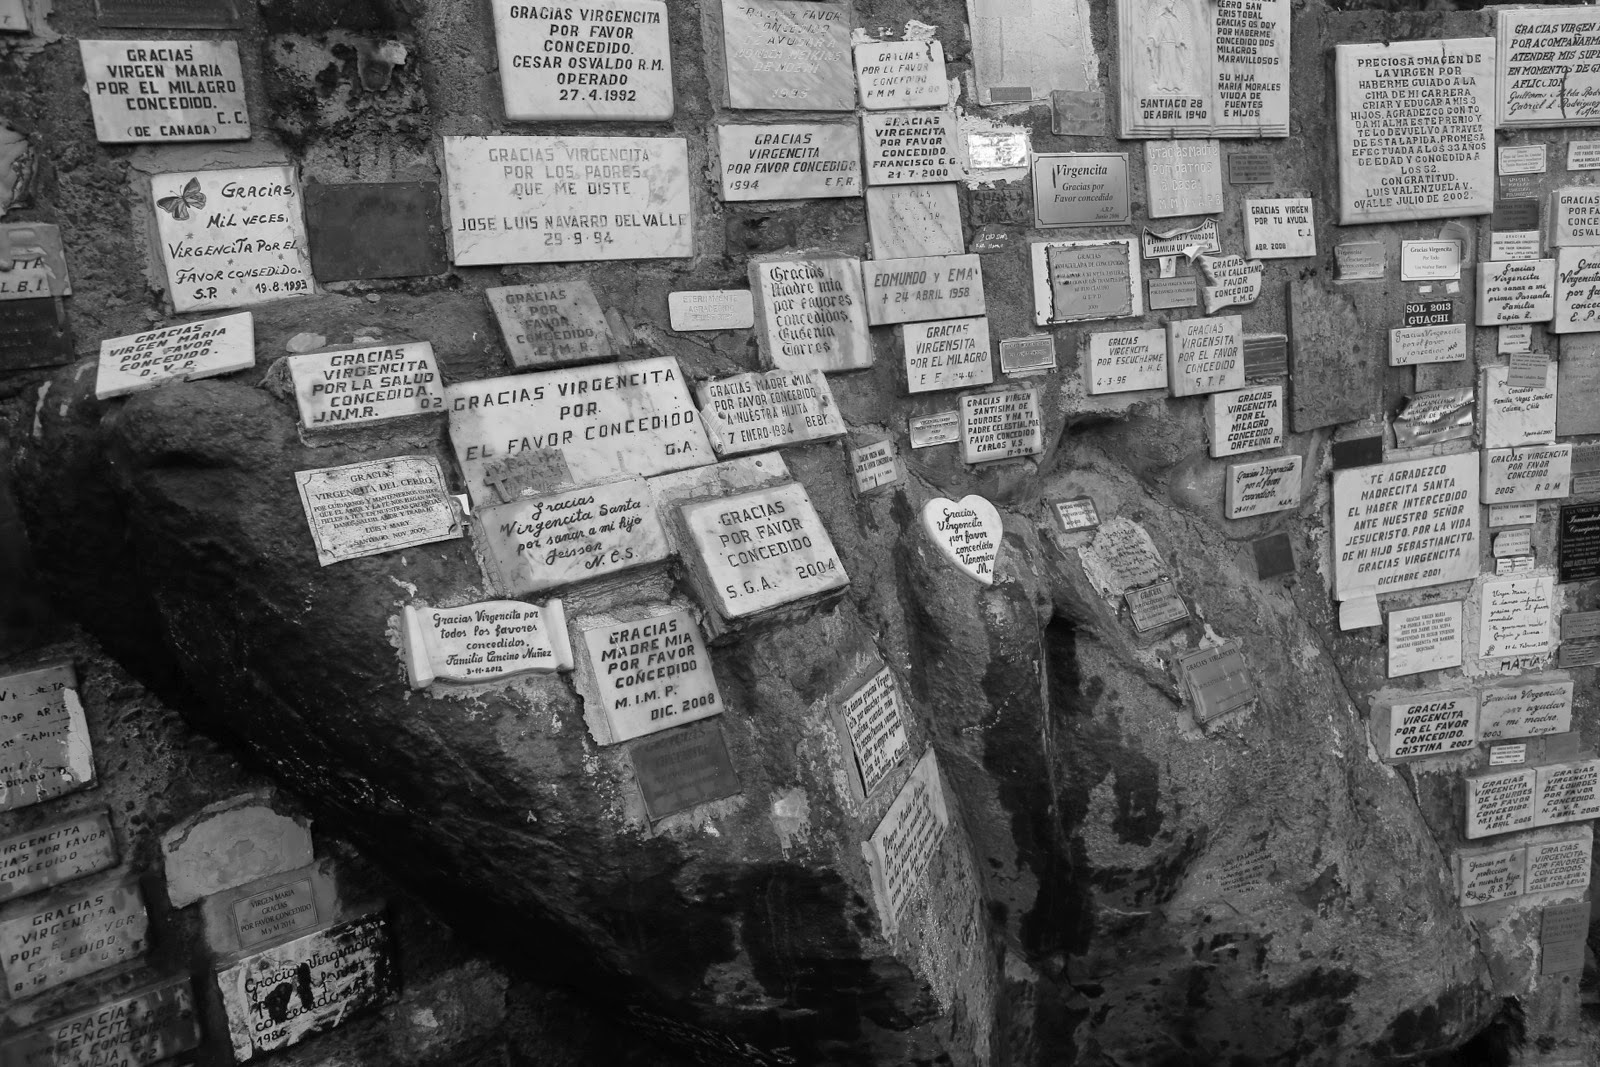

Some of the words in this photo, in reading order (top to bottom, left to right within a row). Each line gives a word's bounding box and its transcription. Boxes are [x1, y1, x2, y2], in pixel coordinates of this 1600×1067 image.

[1217, 1, 1243, 10] CERRO
[1245, 2, 1261, 10] SAN
[510, 5, 573, 20] GRACIAS
[581, 9, 661, 23] VIRGENCITA
[1218, 10, 1263, 19] CRISTOBAL
[550, 25, 579, 37] POR
[590, 25, 633, 39] FAVOR
[544, 40, 634, 55] CONCEDIDO.
[128, 49, 193, 62] GRACIAS
[513, 56, 562, 68] CESAR
[568, 57, 633, 70] OSVALDO
[107, 65, 164, 78] VIRGEN
[177, 65, 222, 77] MARIA
[557, 73, 628, 85] OPERADO
[1412, 78, 1450, 86] GUIADO
[1460, 77, 1476, 86] LA
[97, 82, 129, 95] POR
[140, 81, 159, 94] EL
[169, 80, 236, 94] MILAGRO
[1218, 82, 1242, 90] MARIA
[1245, 83, 1281, 91] MORALES
[127, 97, 217, 109] CONCEDIDO.
[1140, 98, 1186, 108] SANTIAGO
[1191, 98, 1203, 108] 28
[1185, 110, 1207, 119] 1940
[128, 125, 151, 137] (DE
[160, 125, 217, 137] CANADA)
[875, 128, 946, 137] VIRGENCITA
[755, 133, 812, 145] GRACIAS
[880, 138, 900, 146] POR
[906, 137, 942, 145] FAVOR
[749, 147, 820, 159] VIRGENCITA
[727, 164, 751, 174] POR
[754, 163, 788, 173] FAVOR
[873, 159, 934, 168] FRANCISCO
[504, 166, 533, 178] POR
[546, 165, 574, 178] LOS
[1053, 164, 1107, 179] Virgencita
[514, 183, 543, 195] QUE
[555, 183, 577, 195] ME
[589, 183, 630, 195] DISTE
[730, 179, 759, 190] 1994
[1062, 182, 1091, 192] Gracias
[1093, 183, 1104, 192] por
[1366, 189, 1389, 197] LUIS
[1392, 184, 1460, 195] VALENZUELA
[1054, 194, 1076, 203] Favor
[1078, 193, 1113, 202] concedido
[1354, 198, 1392, 208] OVALLE
[1396, 195, 1424, 205] JULIO
[1427, 194, 1439, 202] DE
[1444, 191, 1473, 201] 2002.
[1251, 206, 1280, 215] GRACIAS
[1285, 206, 1309, 215] VIRGEN
[458, 218, 497, 231] JOSE
[504, 217, 538, 230] LUIS
[545, 216, 607, 229] NAVARRO
[1255, 217, 1268, 225] POR
[282, 240, 298, 251] EL
[176, 269, 223, 283] FAVOR
[874, 271, 926, 287] EDMUNDO
[948, 270, 973, 281] EMA
[1406, 305, 1426, 313] SOL
[1430, 303, 1451, 311] 2013
[1409, 314, 1448, 324] GUACHI
[330, 349, 404, 366] GRACIAS
[323, 360, 428, 380] VIRGENCITA
[313, 381, 346, 395] POR
[352, 380, 372, 391] LA
[381, 373, 434, 387] SALUD
[454, 386, 544, 411] GRACIAS
[558, 369, 675, 396] VIRGENCITA
[330, 386, 433, 407] CONCEDIDA.
[560, 402, 597, 419] POR
[781, 405, 808, 417] HIJITA
[1227, 401, 1277, 413] VIRGENCITA
[1236, 412, 1252, 422] POR
[1254, 410, 1265, 419] EL
[1231, 420, 1268, 431] MILAGRO
[466, 445, 493, 461] EL
[508, 431, 573, 453] FAVOR
[585, 411, 694, 440] CONCEDIDO
[1370, 474, 1383, 485] TE
[1389, 465, 1446, 482] AGRADEZCO
[1361, 486, 1418, 501] MADRECITA
[1423, 479, 1455, 491] SANTA
[532, 494, 594, 520] Gracias
[1348, 508, 1361, 517] EL
[1366, 501, 1397, 515] HABER
[1403, 490, 1467, 509] INTERCEDIDO
[501, 508, 593, 537] Virgencita
[600, 500, 641, 516] Santa
[721, 501, 785, 526] GRACIAS
[943, 508, 977, 521] Gracias
[1354, 521, 1378, 531] ANTE
[1383, 513, 1428, 526] NUESTRO
[1433, 503, 1464, 520] SEÑOR
[720, 532, 752, 548] POR
[757, 518, 803, 540] FAVOR
[937, 519, 983, 535] Virgencita
[949, 535, 964, 546] por
[965, 530, 988, 543] favor
[728, 536, 812, 567] CONCEDIDO
[959, 553, 995, 564] Veronica
[795, 558, 836, 580] 2004
[1378, 572, 1418, 586] DICIEMBRE
[1423, 569, 1441, 578] 2001
[433, 613, 472, 627] Gracias
[475, 610, 521, 624] Virgencita
[524, 610, 538, 622] por
[440, 628, 467, 638] todos
[474, 626, 493, 637] los
[496, 623, 537, 636] favores
[601, 640, 659, 662] MADRE
[665, 633, 692, 647] MIA
[446, 652, 483, 665] Familia
[486, 652, 519, 662] Cancino
[523, 648, 551, 659] Nuñez
[608, 658, 639, 674] POR
[647, 646, 694, 667] FAVOR
[1408, 702, 1455, 715] GRACIAS
[1403, 711, 1463, 725] VIRGENCITA
[1395, 725, 1416, 736] POR
[1420, 725, 1432, 733] EL
[1435, 719, 1469, 730] FAVOR
[1395, 742, 1442, 755] CRISTINA
[1450, 740, 1472, 748] 2007
[1493, 789, 1532, 801] LOURDES
[1480, 802, 1497, 810] POR
[1501, 796, 1530, 807] FAVOR
[250, 897, 273, 909] VIRGEN
[275, 890, 295, 900] MARIA
[261, 902, 288, 915] GRACIAS
[240, 923, 253, 933] POR
[255, 918, 275, 927] FAVOR
[276, 903, 312, 919] CONCEDIDO
